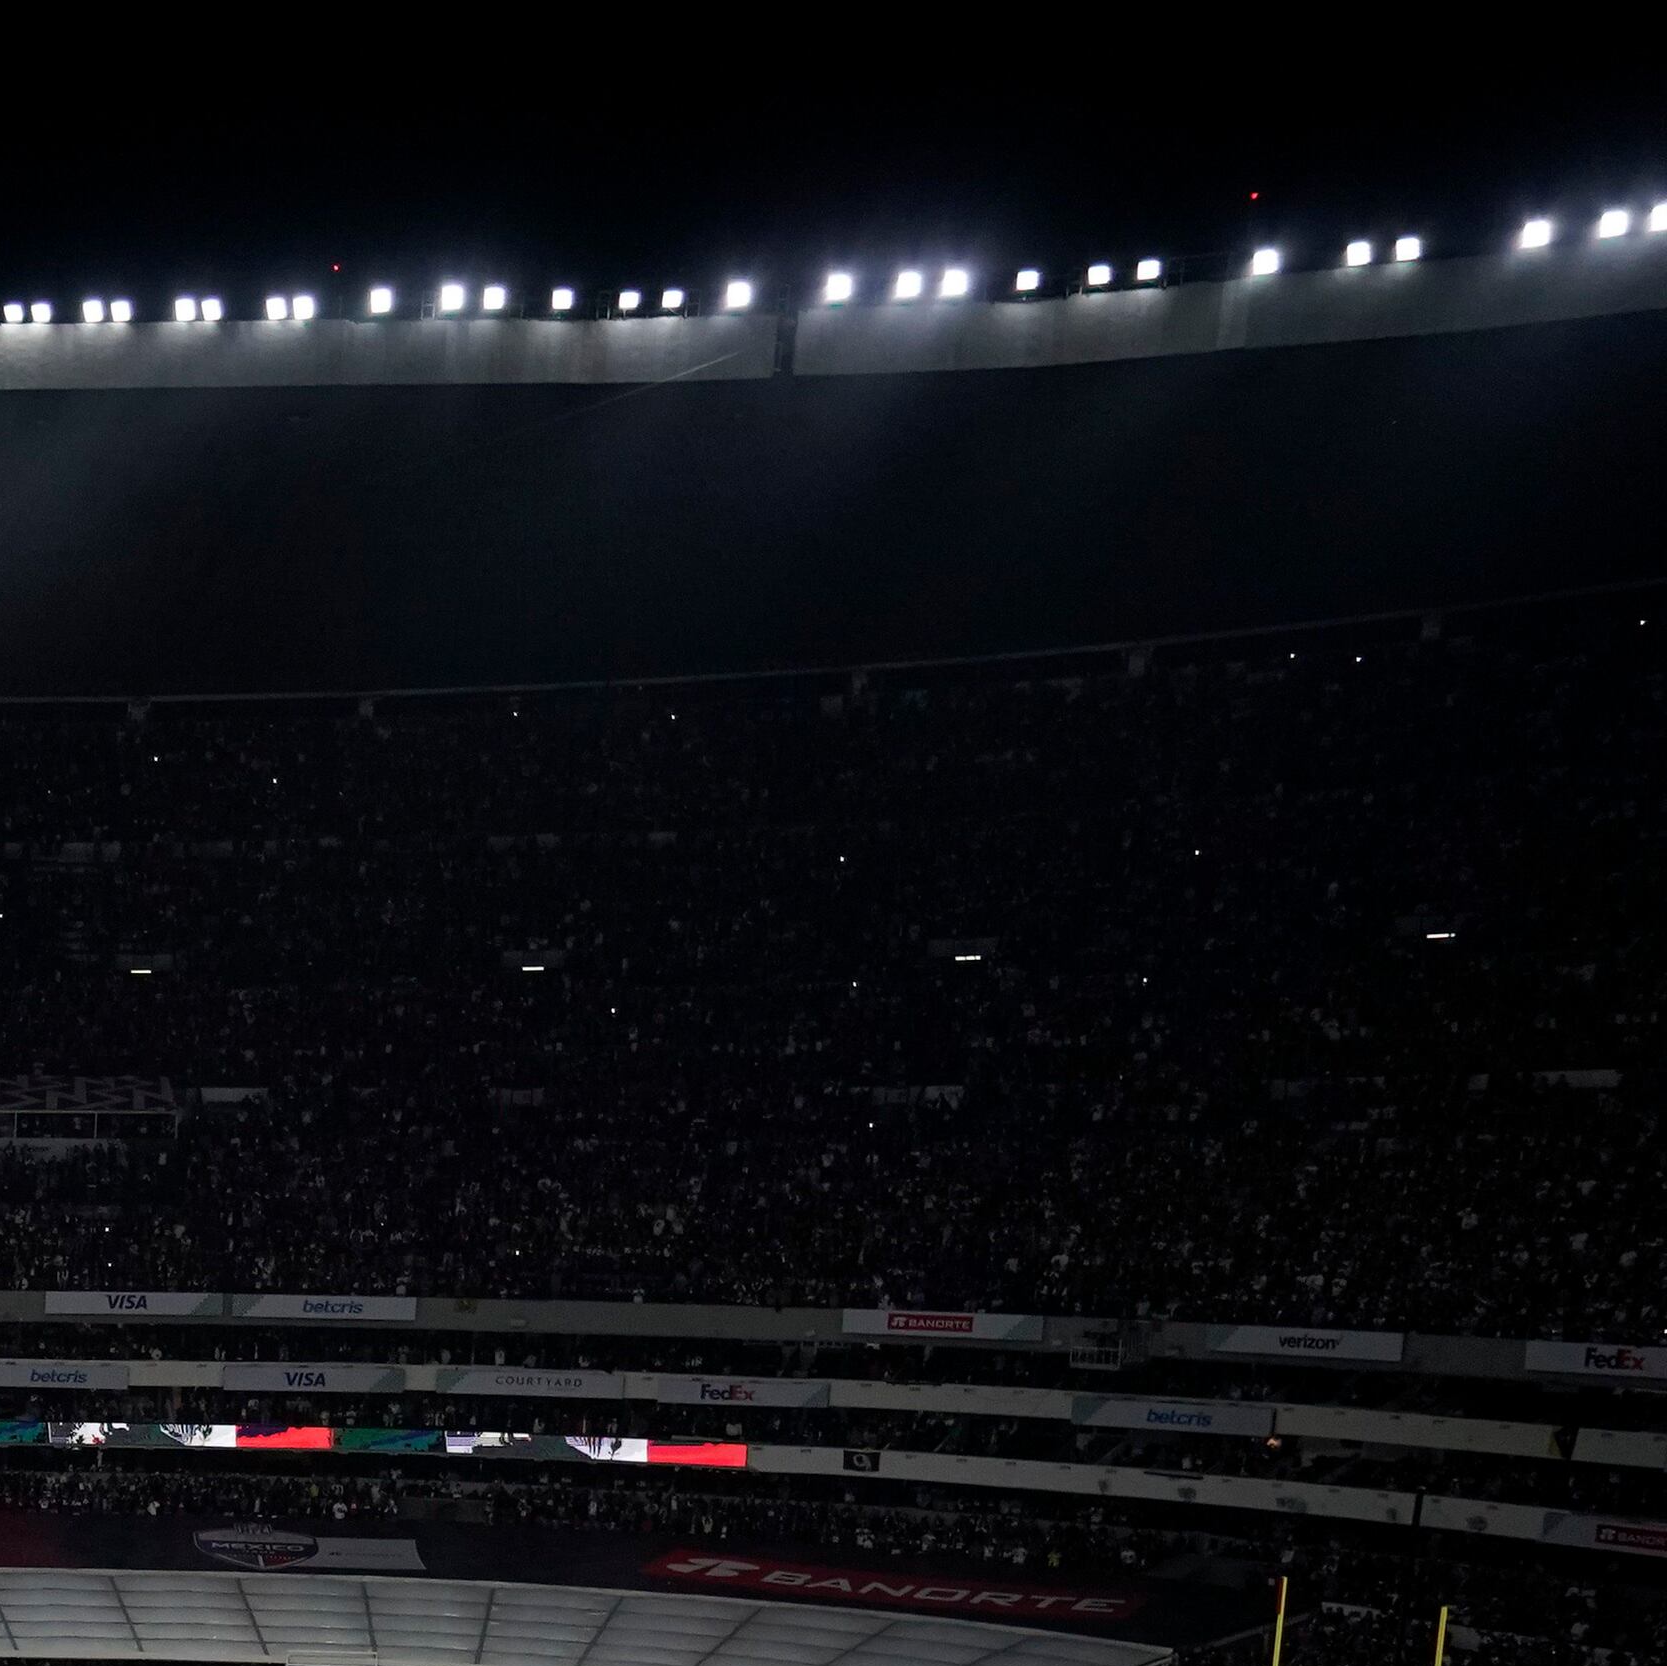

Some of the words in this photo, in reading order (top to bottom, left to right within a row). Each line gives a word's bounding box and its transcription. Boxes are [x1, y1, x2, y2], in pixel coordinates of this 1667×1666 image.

[107, 1295, 148, 1310] VISA
[303, 1298, 363, 1314] betcris
[909, 1318, 971, 1331] BANORTE
[1279, 1335, 1336, 1351] verizon
[1584, 1347, 1643, 1371] FedEx
[30, 1369, 88, 1384] betcris
[285, 1372, 326, 1387] VISA
[496, 1376, 582, 1387] COURTYARD
[701, 1384, 755, 1401] FedEx
[1148, 1408, 1212, 1428] betcris
[211, 1542, 304, 1552] MEXICO
[760, 1572, 1126, 1614] BANORTE
